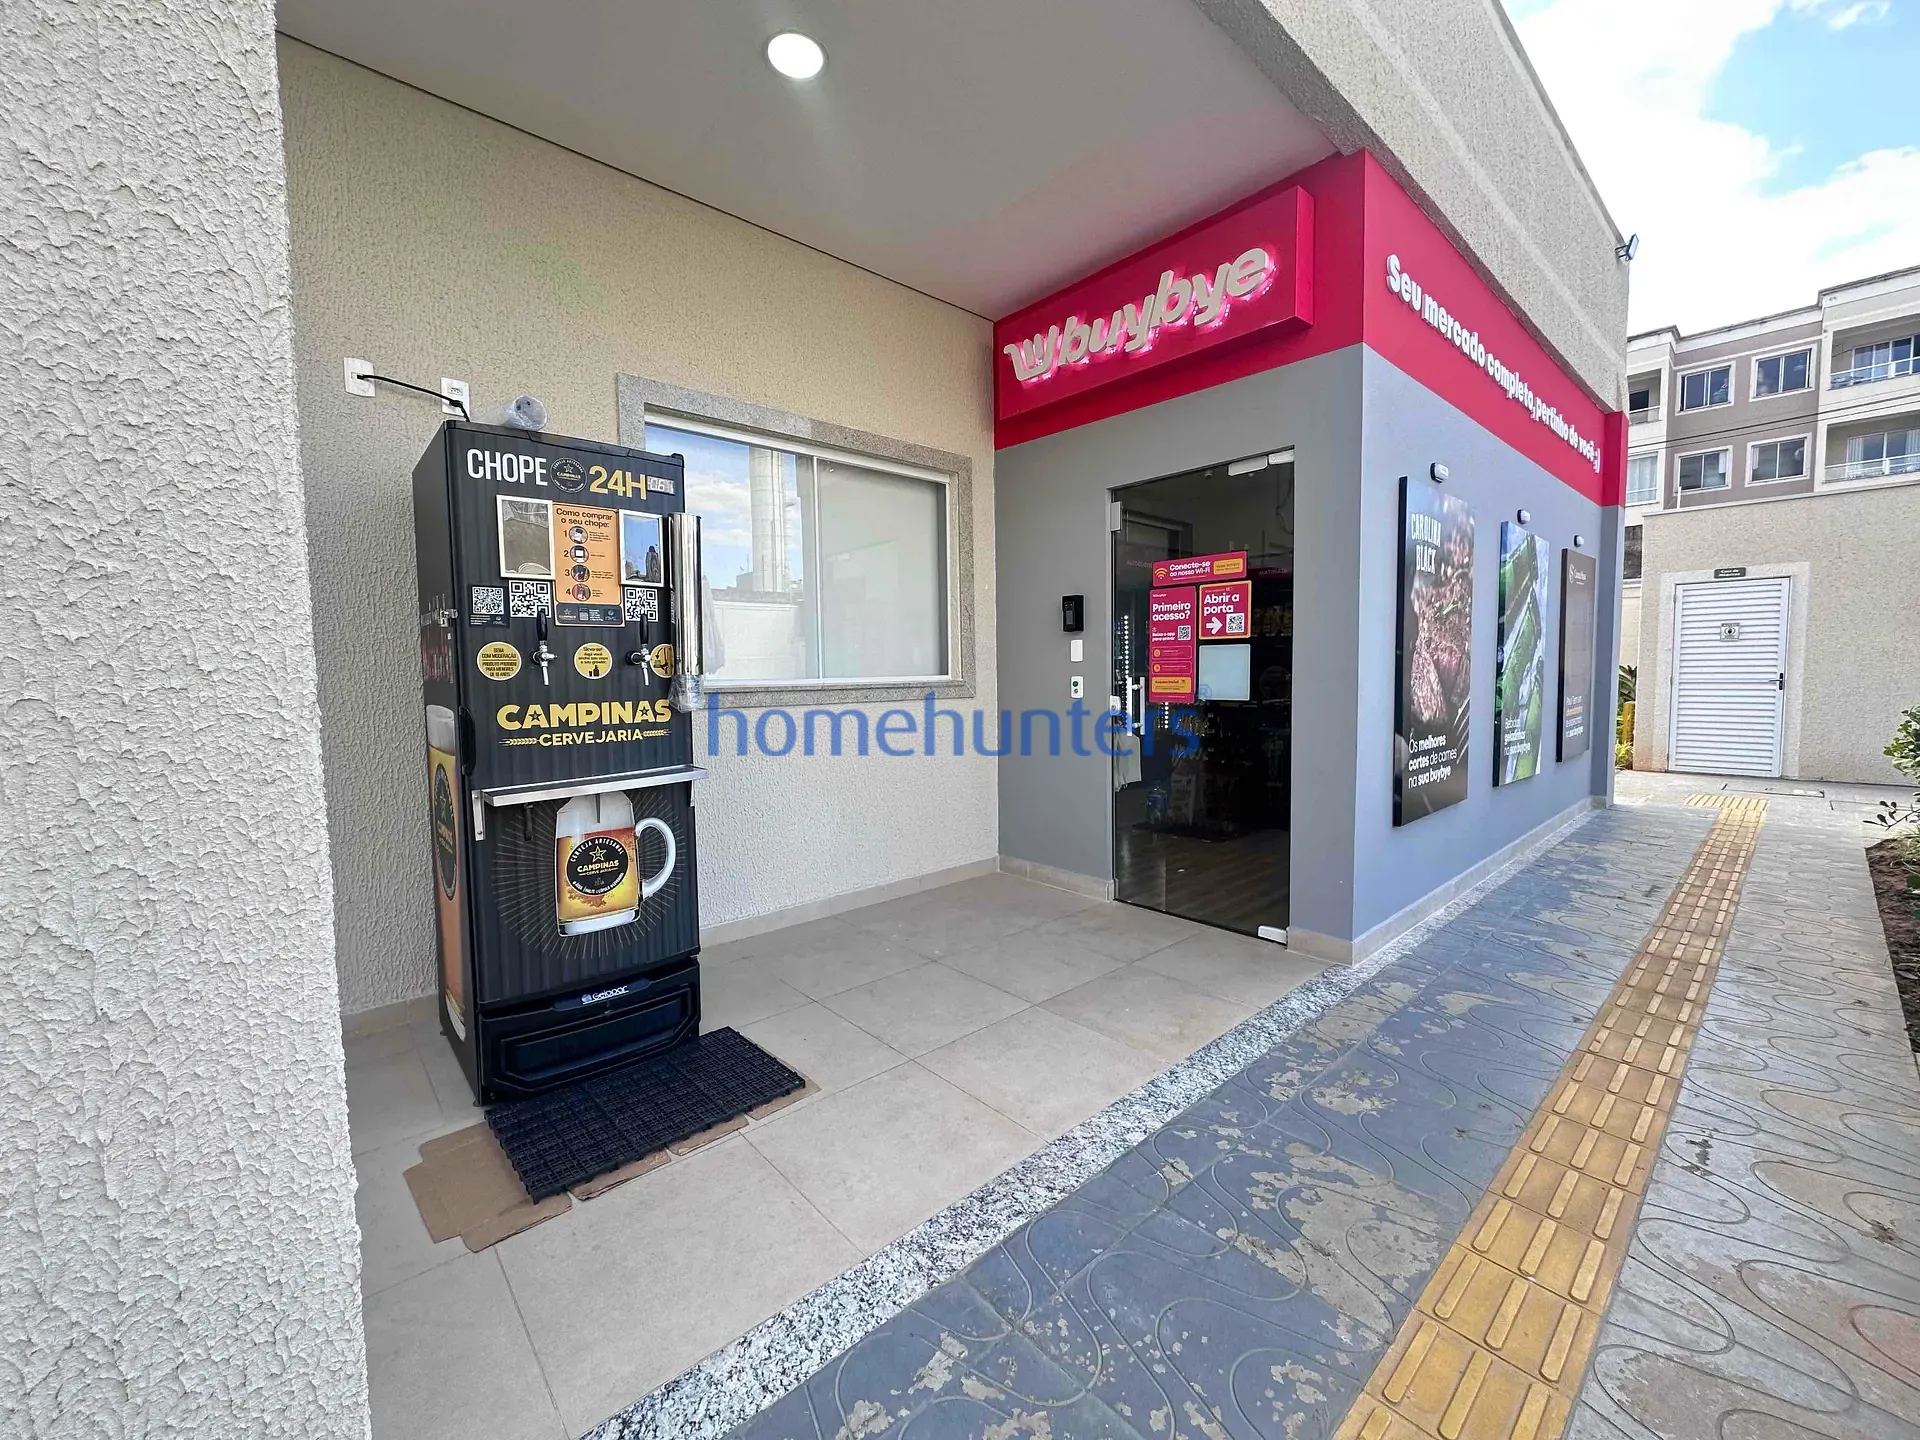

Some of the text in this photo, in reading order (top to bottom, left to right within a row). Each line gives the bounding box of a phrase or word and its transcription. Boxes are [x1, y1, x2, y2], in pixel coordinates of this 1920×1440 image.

[1386, 254, 1422, 312] Seu
[1421, 293, 1486, 368] mercado
[1486, 353, 1535, 420] completo,
[1534, 397, 1569, 441] pertinho
[1569, 424, 1579, 449] de
[467, 448, 548, 486] CHOPE
[589, 465, 647, 500] 24H
[556, 508, 613, 521] Como comprar
[569, 517, 583, 525] seu
[585, 519, 609, 529] chope:
[563, 530, 568, 538] 1
[1411, 513, 1442, 548] CAROLINA
[563, 550, 569, 558] 2
[1416, 544, 1437, 575] BLACK
[1169, 561, 1211, 571] Conecte-se
[564, 569, 570, 577] 3
[565, 588, 571, 596] 4
[1204, 592, 1240, 604] Abrir a
[1152, 601, 1191, 612] Primeiro
[1204, 604, 1234, 616] porta
[1152, 610, 1190, 622] acesso?
[496, 698, 672, 731] CAMPINAS
[538, 728, 644, 746] CERVEJARIA
[1408, 734, 1447, 753] Os melhores
[1408, 755, 1429, 772] cortes
[1430, 751, 1438, 765] de
[1408, 765, 1451, 789] na sua buybye
[570, 840, 592, 862] CERVEJA
[577, 860, 620, 873] CAMPINAS
